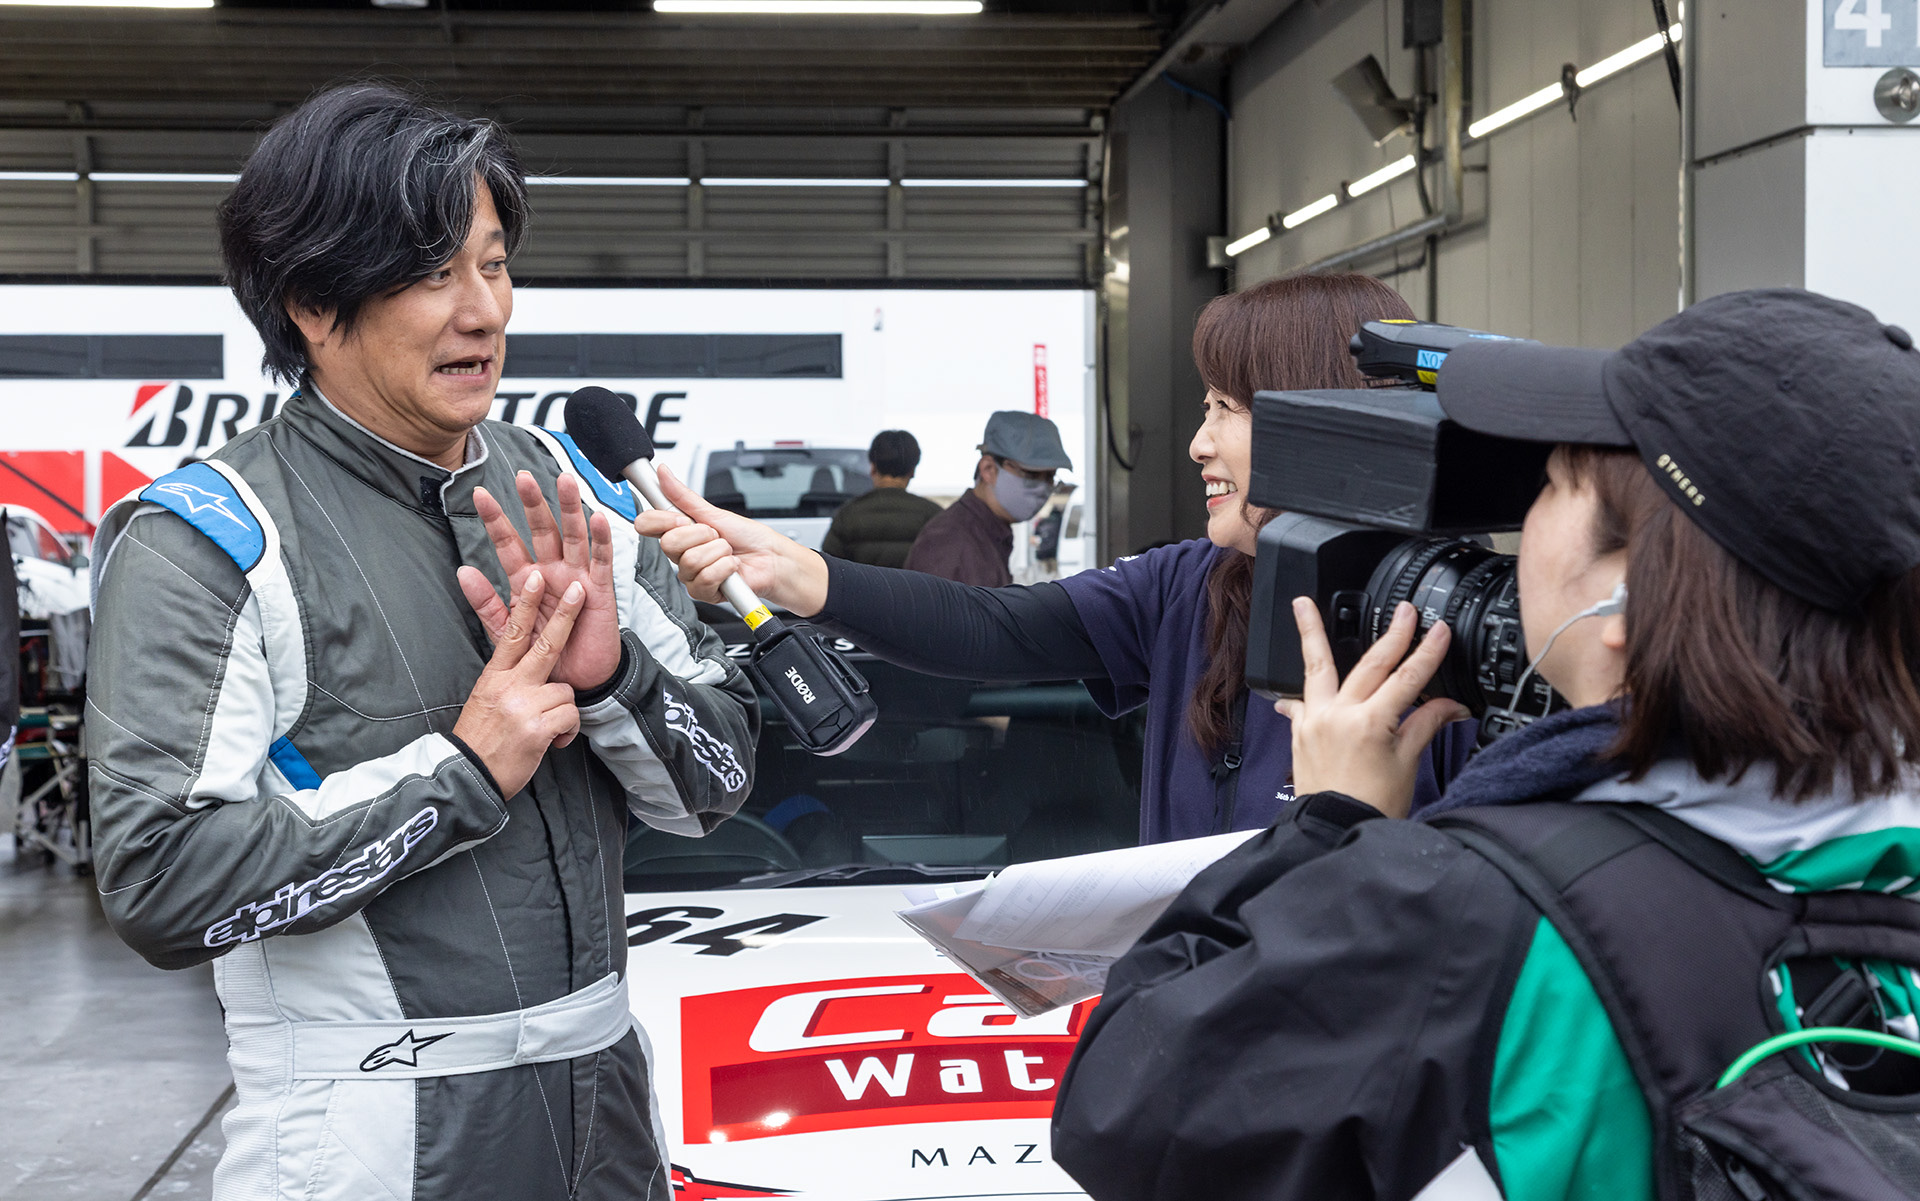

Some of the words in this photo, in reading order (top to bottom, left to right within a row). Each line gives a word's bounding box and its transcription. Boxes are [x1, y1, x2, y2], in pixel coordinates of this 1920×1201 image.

[1834, 0, 1920, 48] 4
[125, 381, 688, 449] BRITOE
[1656, 453, 1706, 506] OTHERS
[784, 666, 816, 705] RØDE
[663, 685, 747, 793] pinestars
[203, 806, 439, 948] alpinestars
[628, 906, 829, 957] 64
[748, 984, 1075, 1053] Ca
[825, 1049, 1056, 1101] Wat
[912, 1143, 1043, 1168] MAZ
